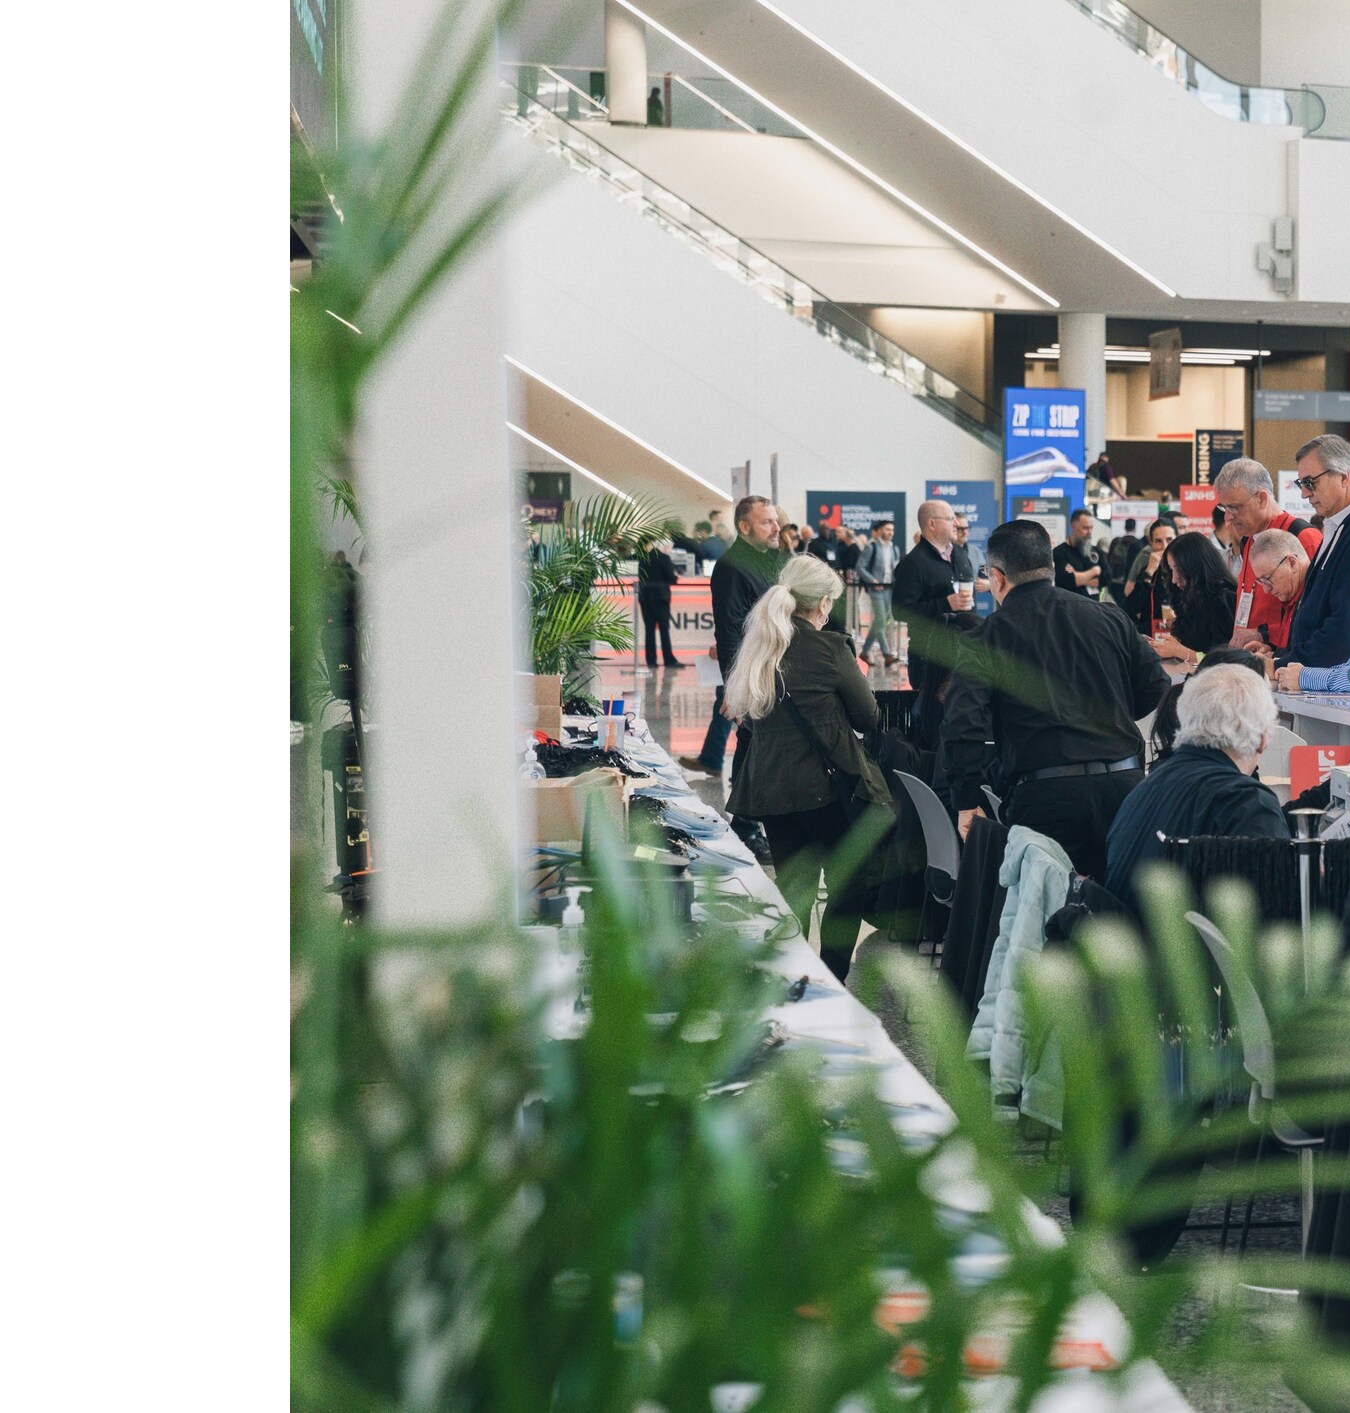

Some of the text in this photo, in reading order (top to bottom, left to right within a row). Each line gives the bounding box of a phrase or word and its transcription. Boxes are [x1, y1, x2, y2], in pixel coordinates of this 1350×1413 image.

[1012, 404, 1030, 427] ZIP
[1049, 404, 1080, 428] STRIP
[939, 485, 958, 496] NHS
[1194, 490, 1216, 500] NHS
[669, 612, 714, 630] NHS
